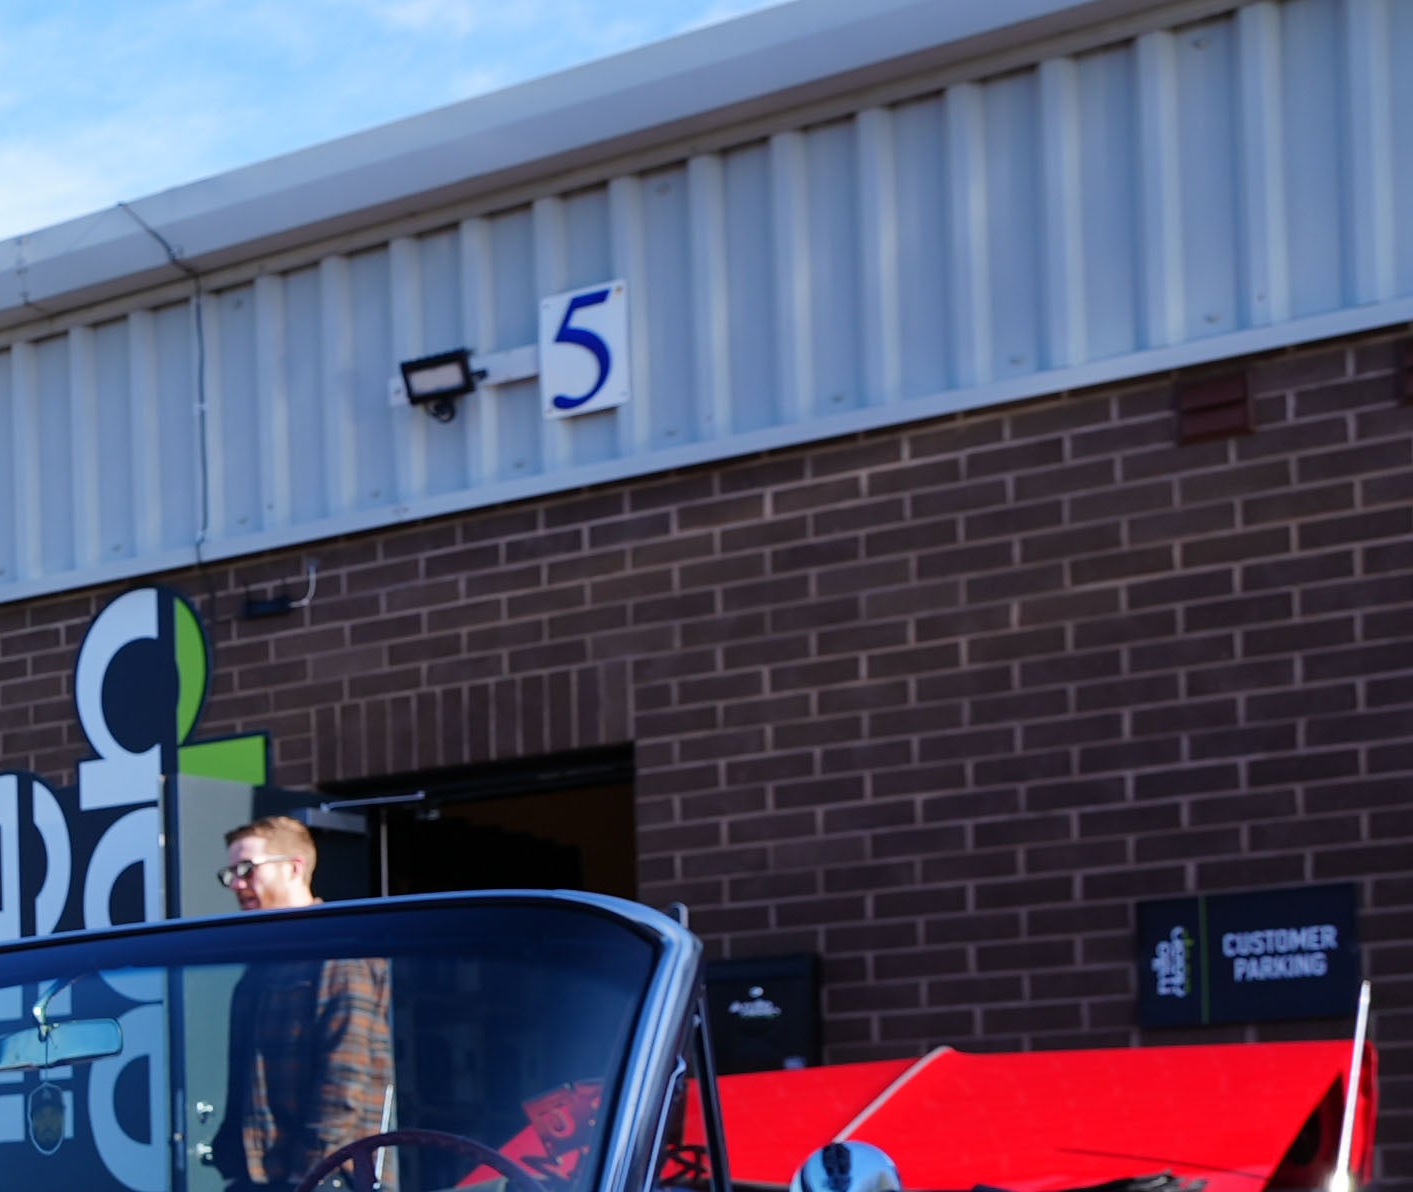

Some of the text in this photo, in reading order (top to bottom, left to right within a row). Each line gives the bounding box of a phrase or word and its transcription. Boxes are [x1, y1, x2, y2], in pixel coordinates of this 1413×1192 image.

[552, 287, 613, 410] 5
[1222, 924, 1339, 958] CUSTOMER
[1233, 952, 1328, 983] PARKING
